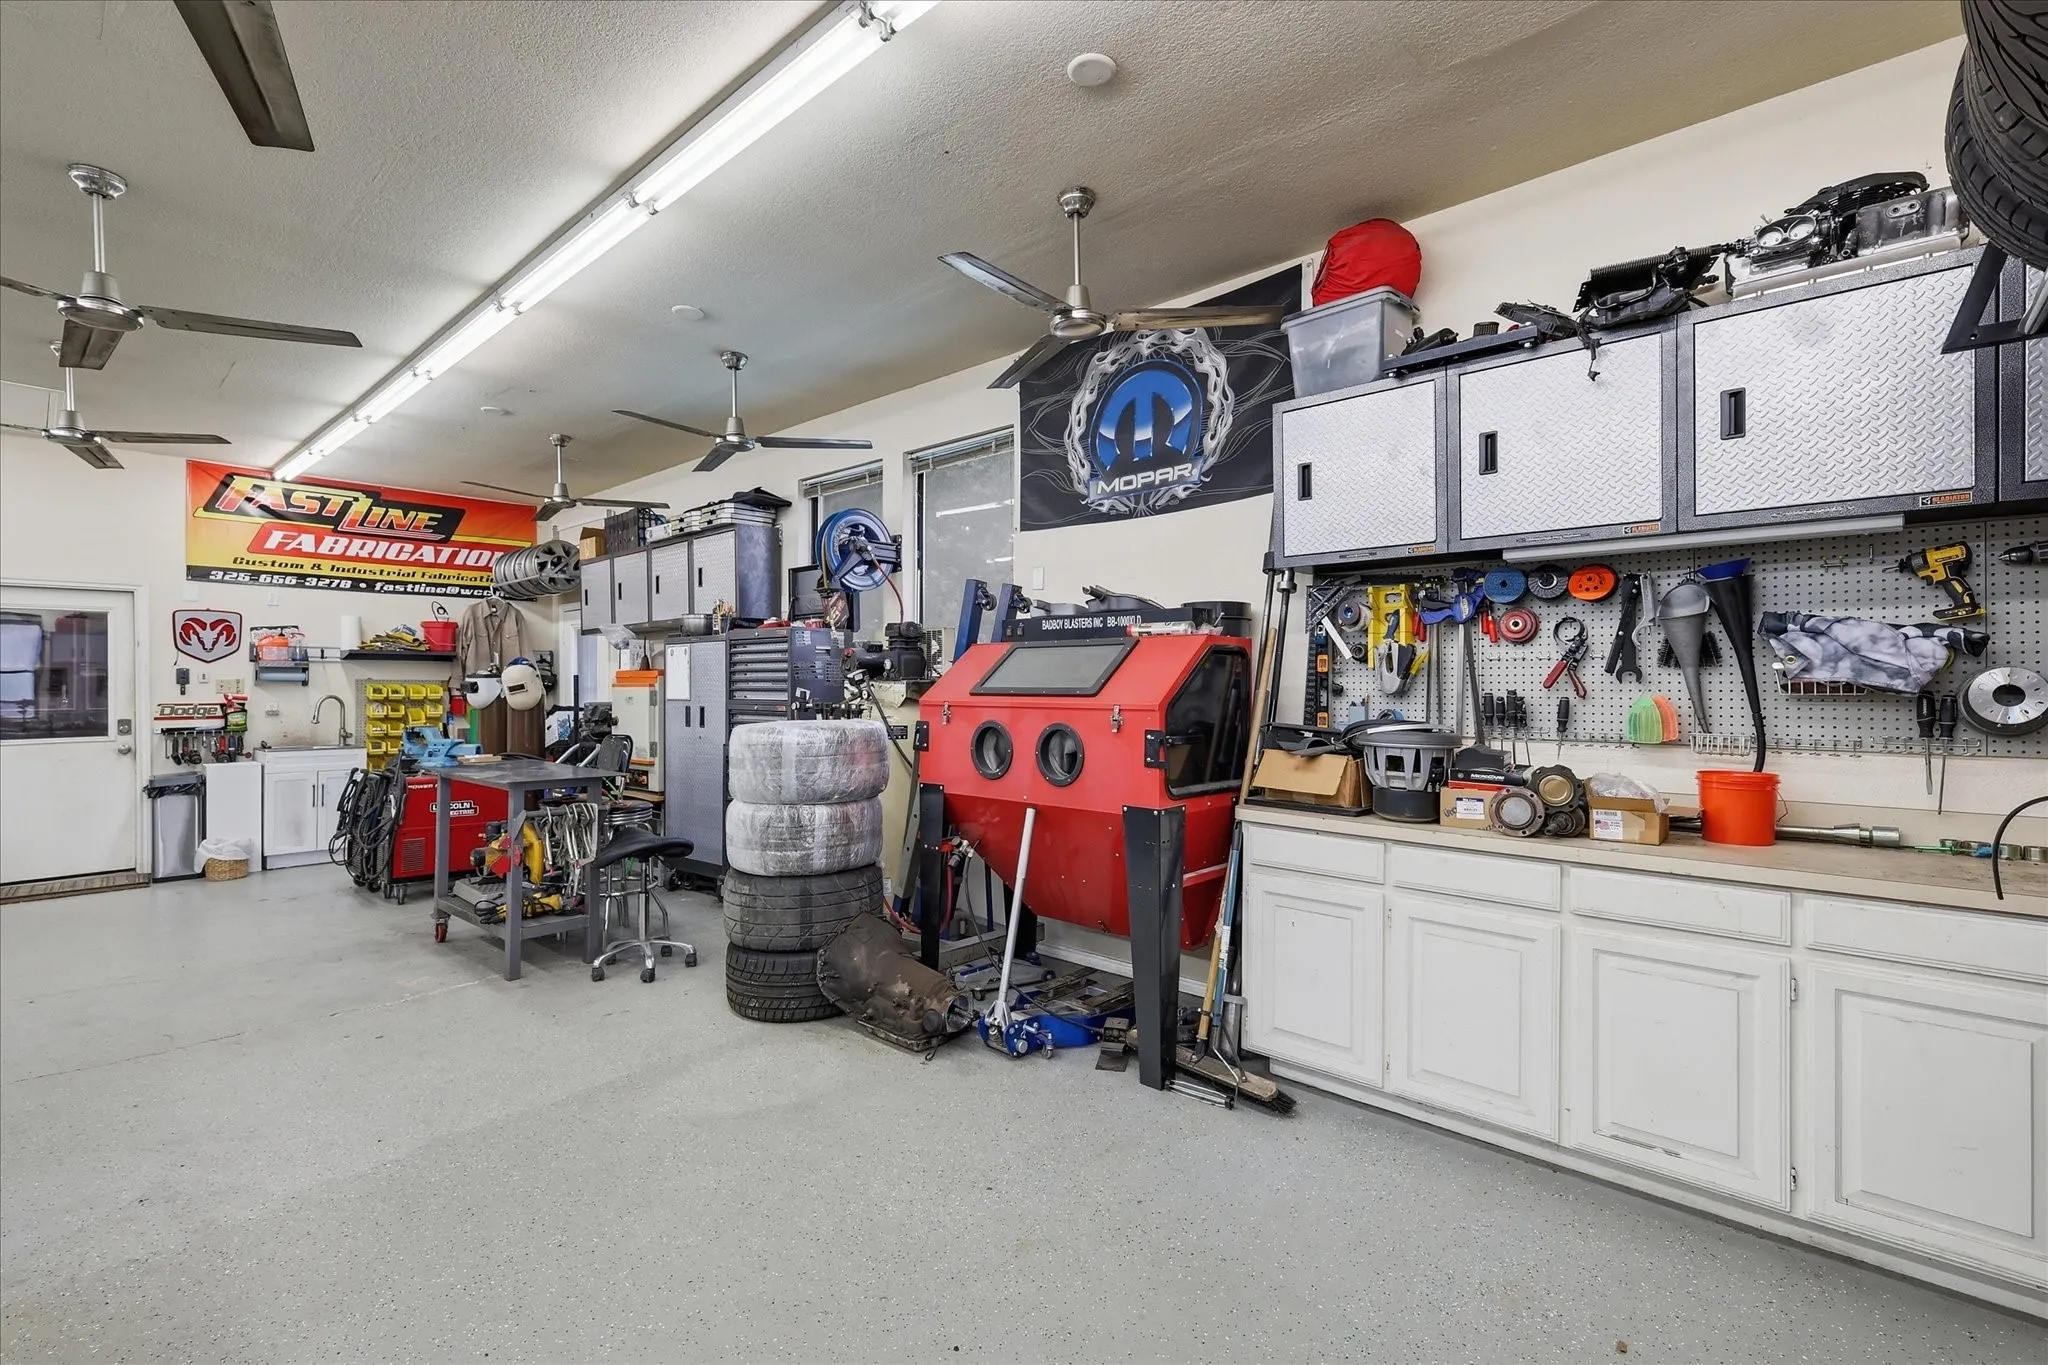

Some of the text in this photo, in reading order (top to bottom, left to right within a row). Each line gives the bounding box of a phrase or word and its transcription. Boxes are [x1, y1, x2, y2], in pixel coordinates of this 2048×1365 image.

[1097, 463, 1193, 494] MOPAR
[233, 556, 304, 570] Custom
[310, 563, 323, 571] &
[330, 564, 416, 578] Industrial
[209, 570, 352, 589] 325-656-3278
[1042, 619, 1064, 630] BADBOY
[1064, 617, 1092, 629] BLASTERS
[1093, 616, 1103, 628] INC
[160, 703, 218, 719] Dodge
[433, 802, 471, 811] LCOLN
